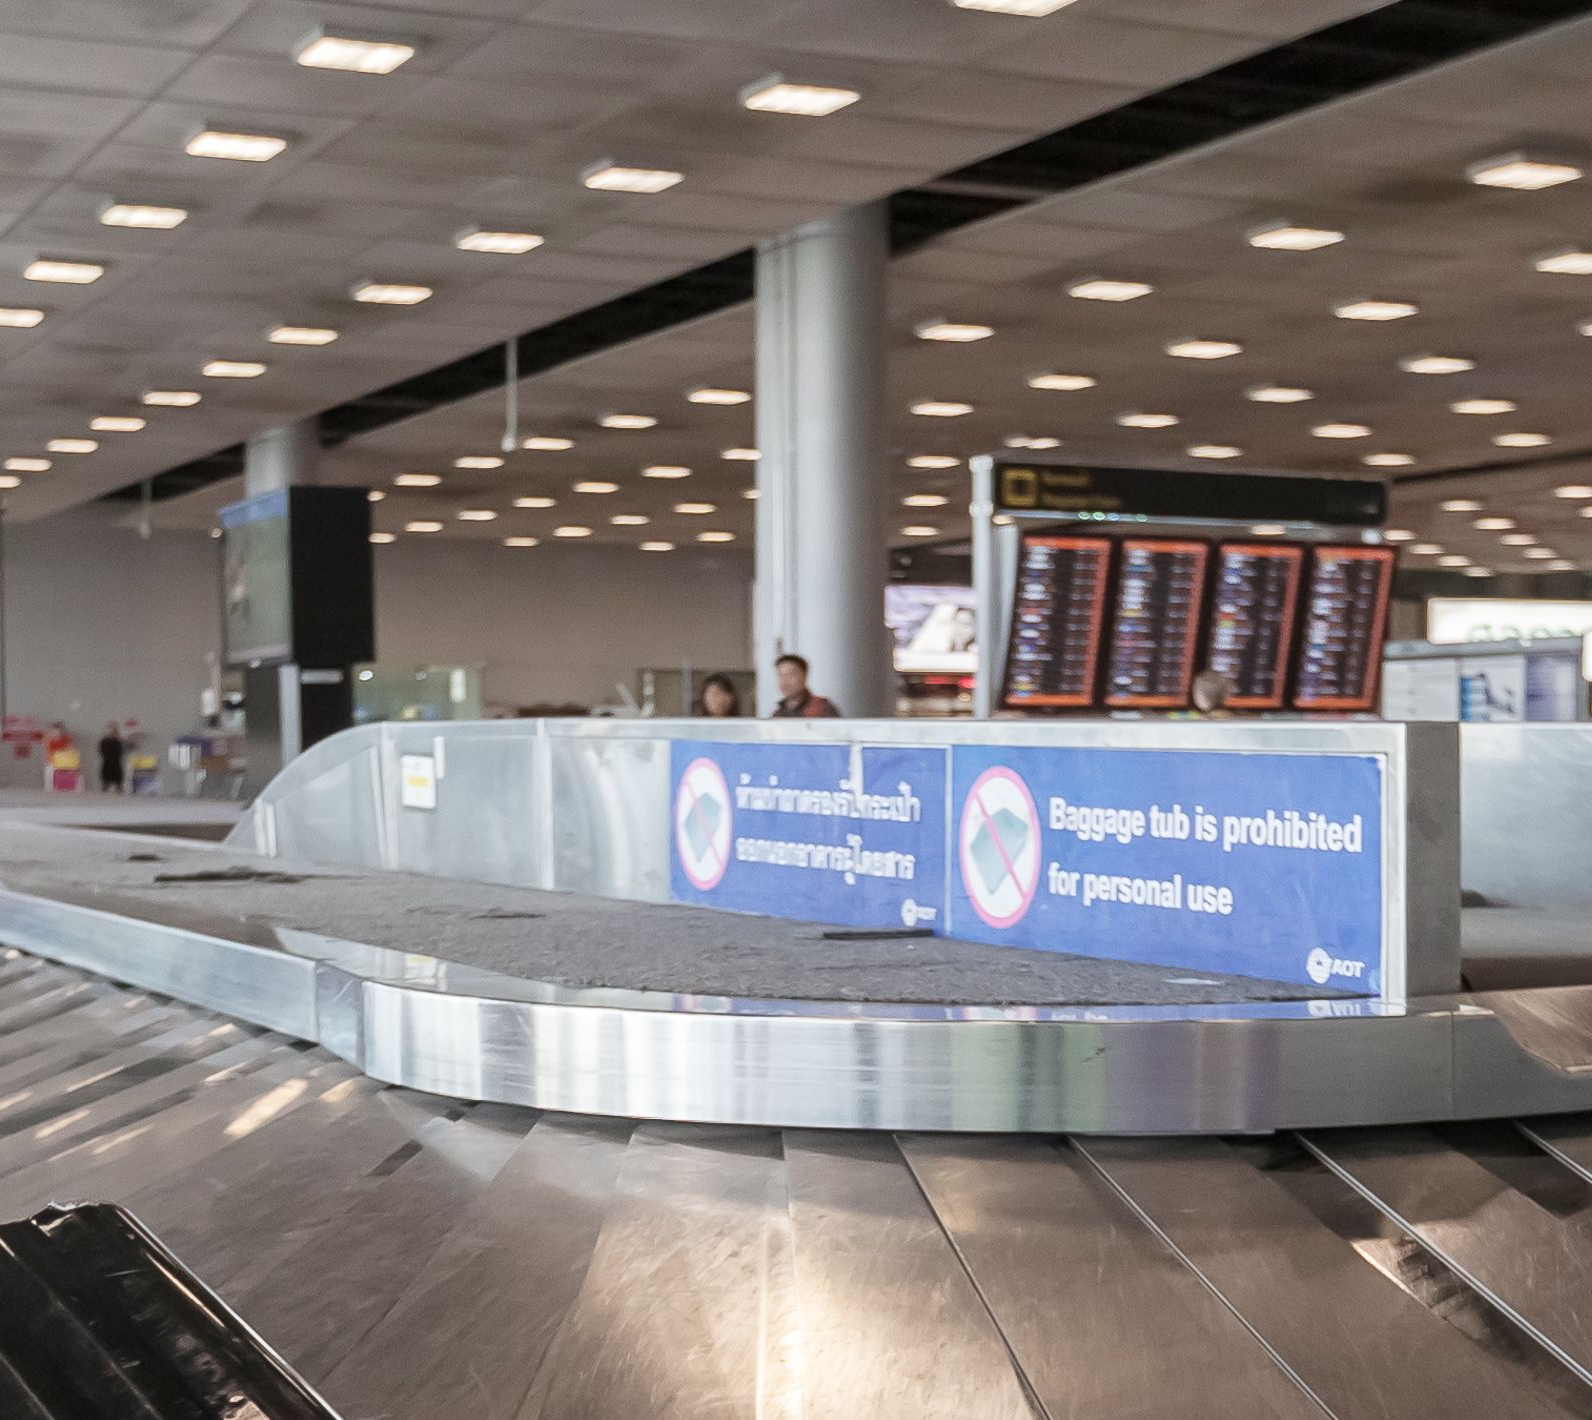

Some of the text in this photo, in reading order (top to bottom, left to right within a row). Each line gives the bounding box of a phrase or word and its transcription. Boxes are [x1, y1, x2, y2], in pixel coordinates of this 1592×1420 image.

[1049, 796, 1363, 854] Baggage tub is prohibited
[1047, 861, 1234, 916] for personal use
[1328, 957, 1366, 978] AOT
